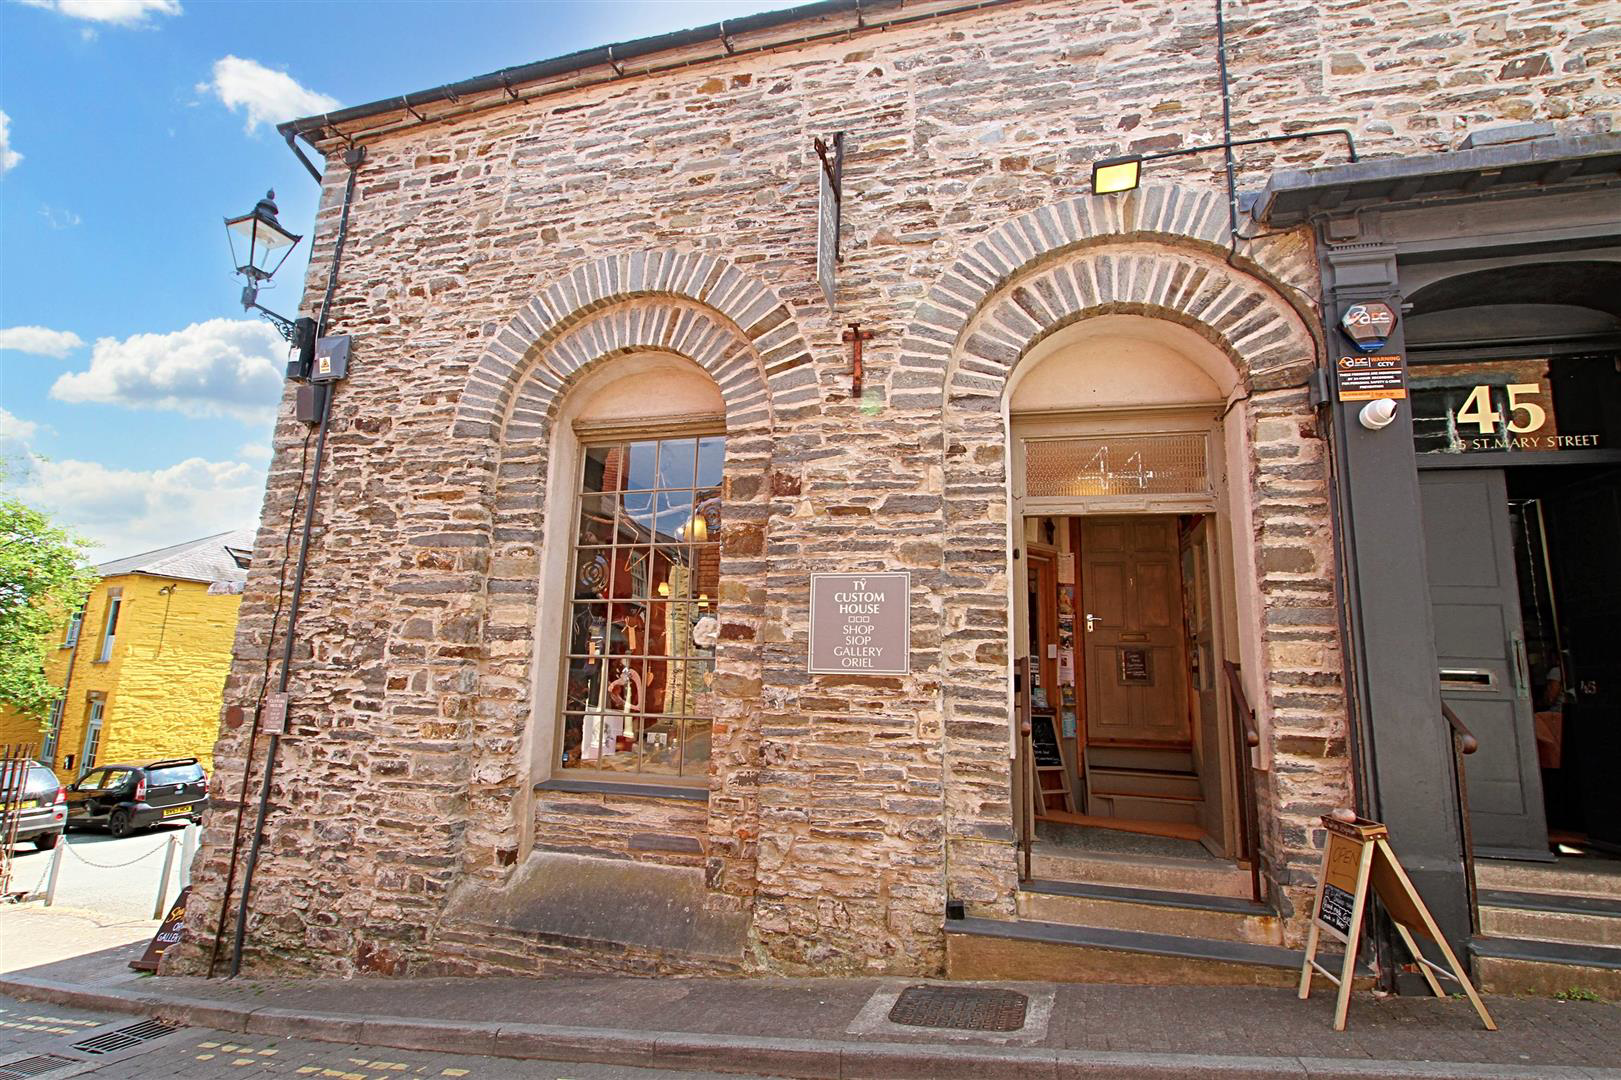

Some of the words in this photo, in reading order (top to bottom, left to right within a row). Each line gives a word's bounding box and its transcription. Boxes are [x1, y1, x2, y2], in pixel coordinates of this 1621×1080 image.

[1457, 383, 1546, 434] 45
[1547, 434, 1600, 448] STREET
[1078, 446, 1154, 490] 44
[834, 592, 885, 603] CUSTOM
[839, 603, 880, 614] HOUSE
[842, 624, 875, 635] SHOP
[845, 635, 872, 646] SIOP
[833, 646, 884, 657] GALLERY
[841, 658, 874, 668] ORIEL
